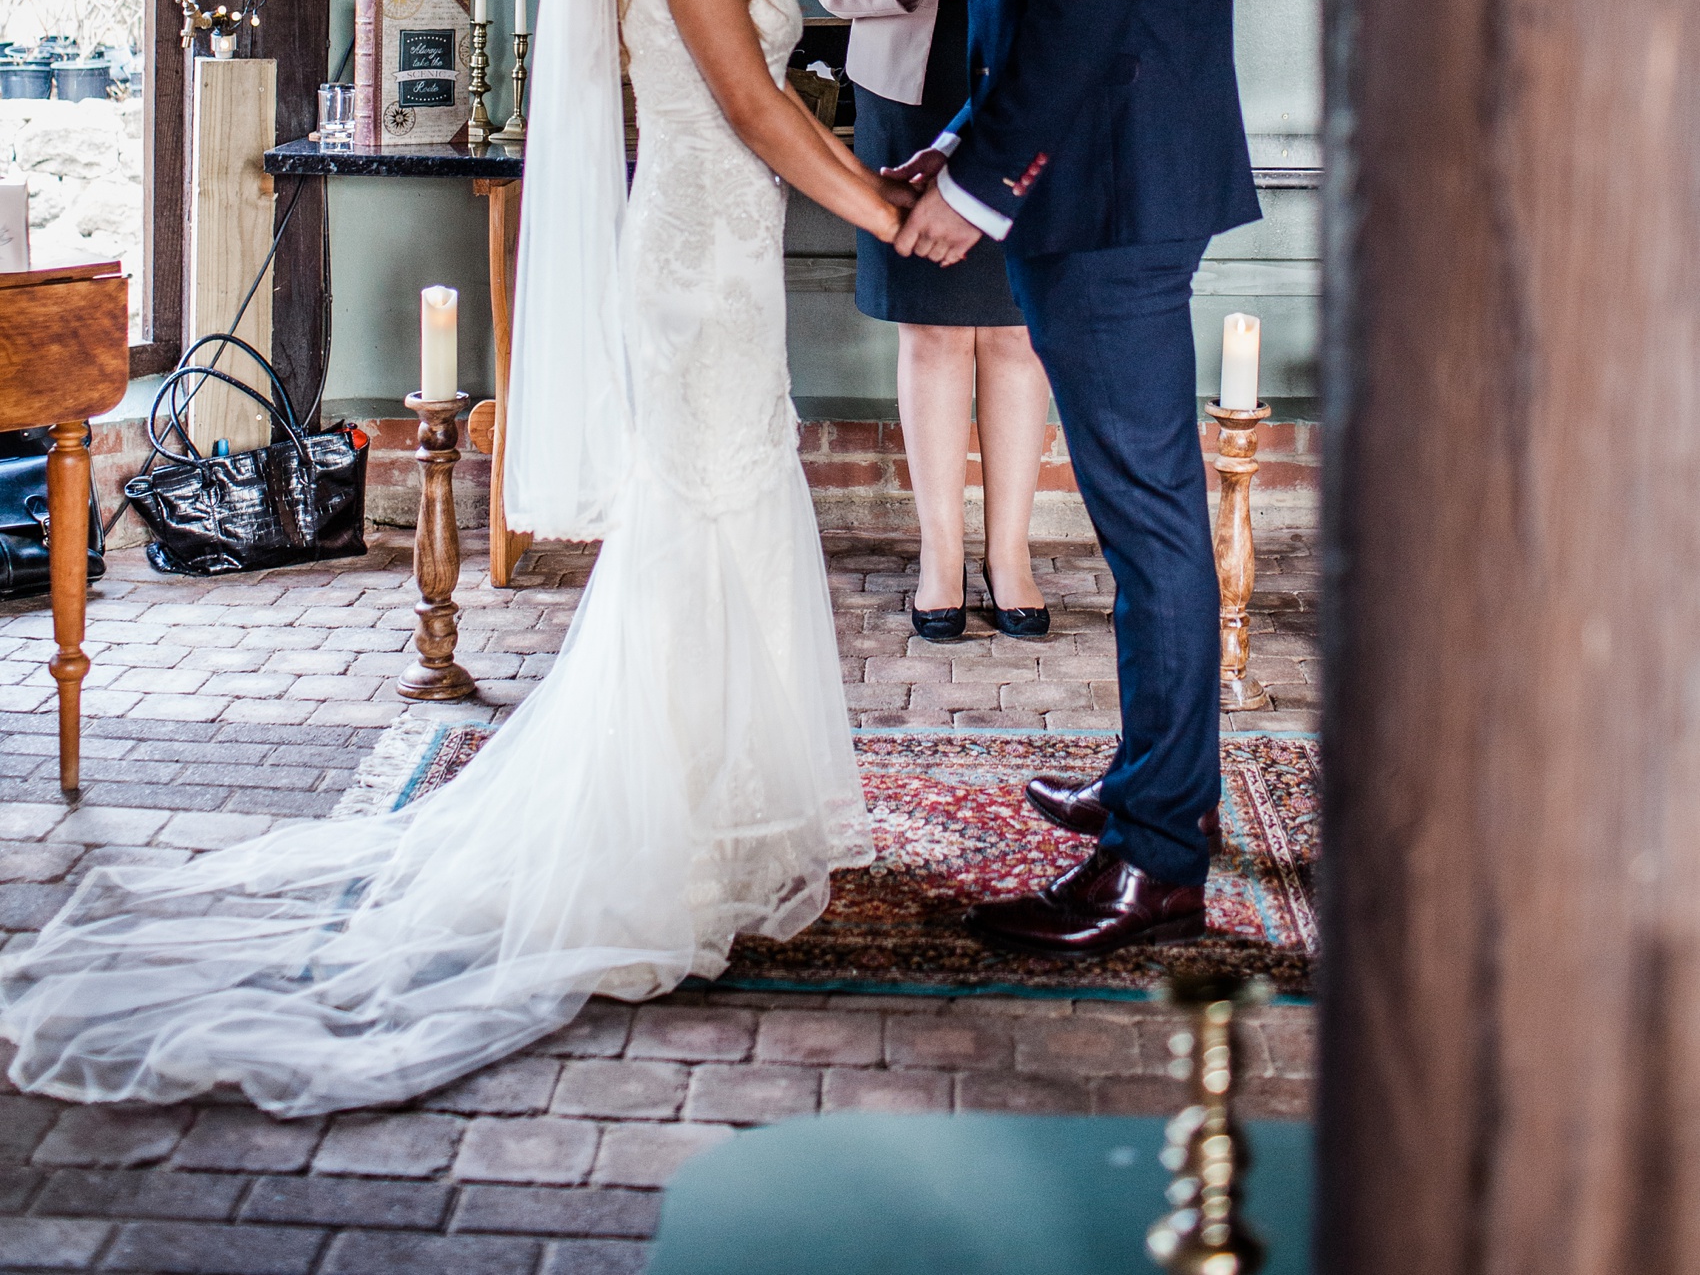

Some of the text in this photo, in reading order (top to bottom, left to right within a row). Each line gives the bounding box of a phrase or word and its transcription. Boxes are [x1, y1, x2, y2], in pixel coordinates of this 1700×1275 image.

[410, 42, 443, 59] Always
[412, 57, 443, 67] take the
[407, 70, 446, 79] SCENIC
[413, 81, 439, 93] Route
